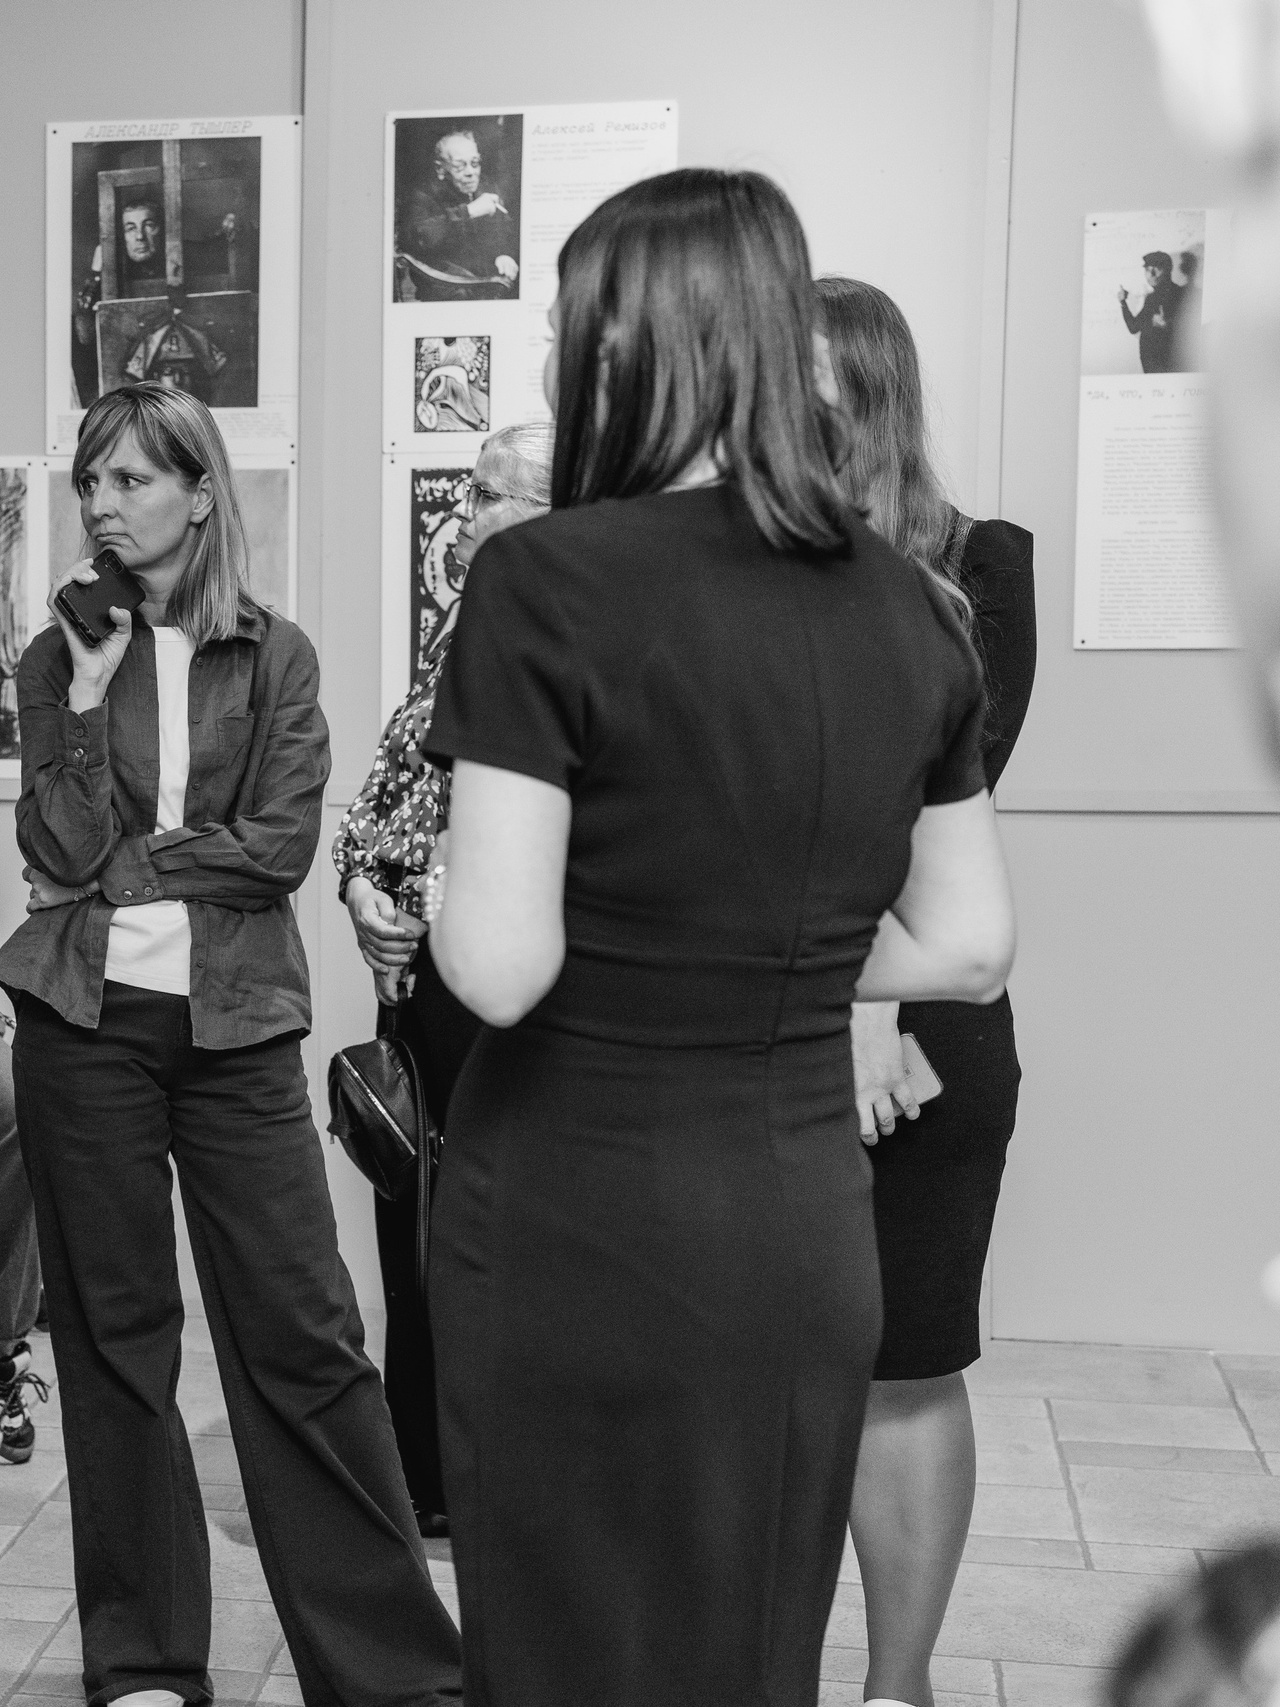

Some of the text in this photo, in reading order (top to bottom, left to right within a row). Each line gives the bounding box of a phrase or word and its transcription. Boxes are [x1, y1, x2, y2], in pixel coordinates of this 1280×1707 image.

[84, 122, 180, 138] АЛЕКСАНДР
[532, 121, 667, 135] Алексей Ремизов
